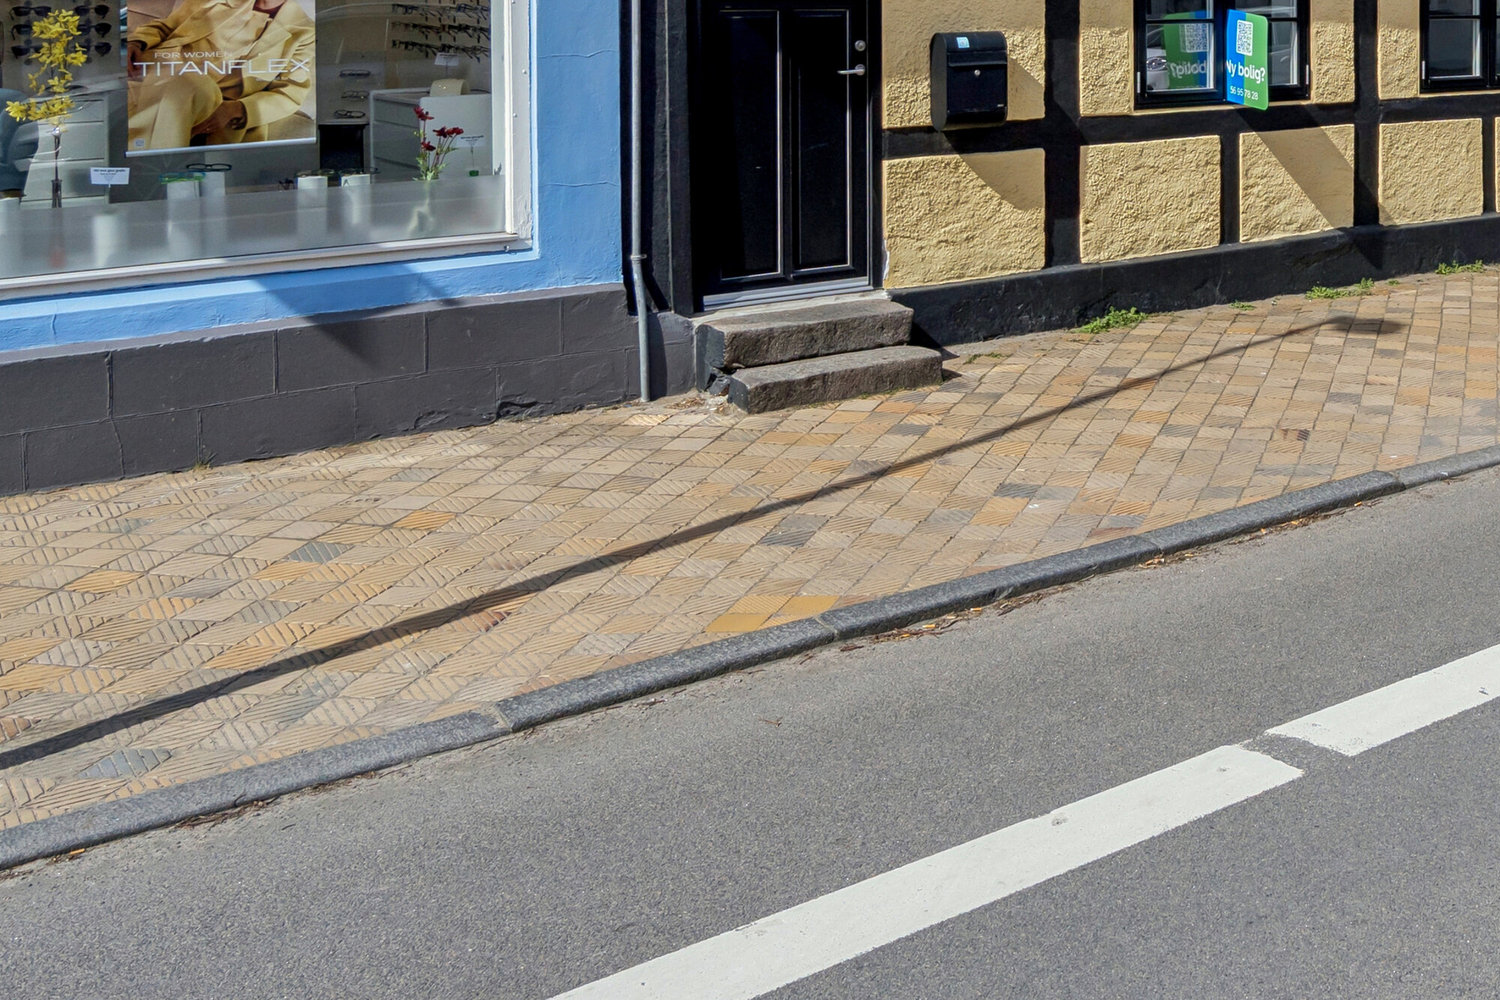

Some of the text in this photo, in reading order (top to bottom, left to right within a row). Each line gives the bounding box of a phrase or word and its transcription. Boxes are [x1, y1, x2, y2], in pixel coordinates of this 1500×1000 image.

[154, 51, 181, 59] FOR
[133, 58, 310, 77] TITANFLEX
[1238, 61, 1266, 84] bolig?
